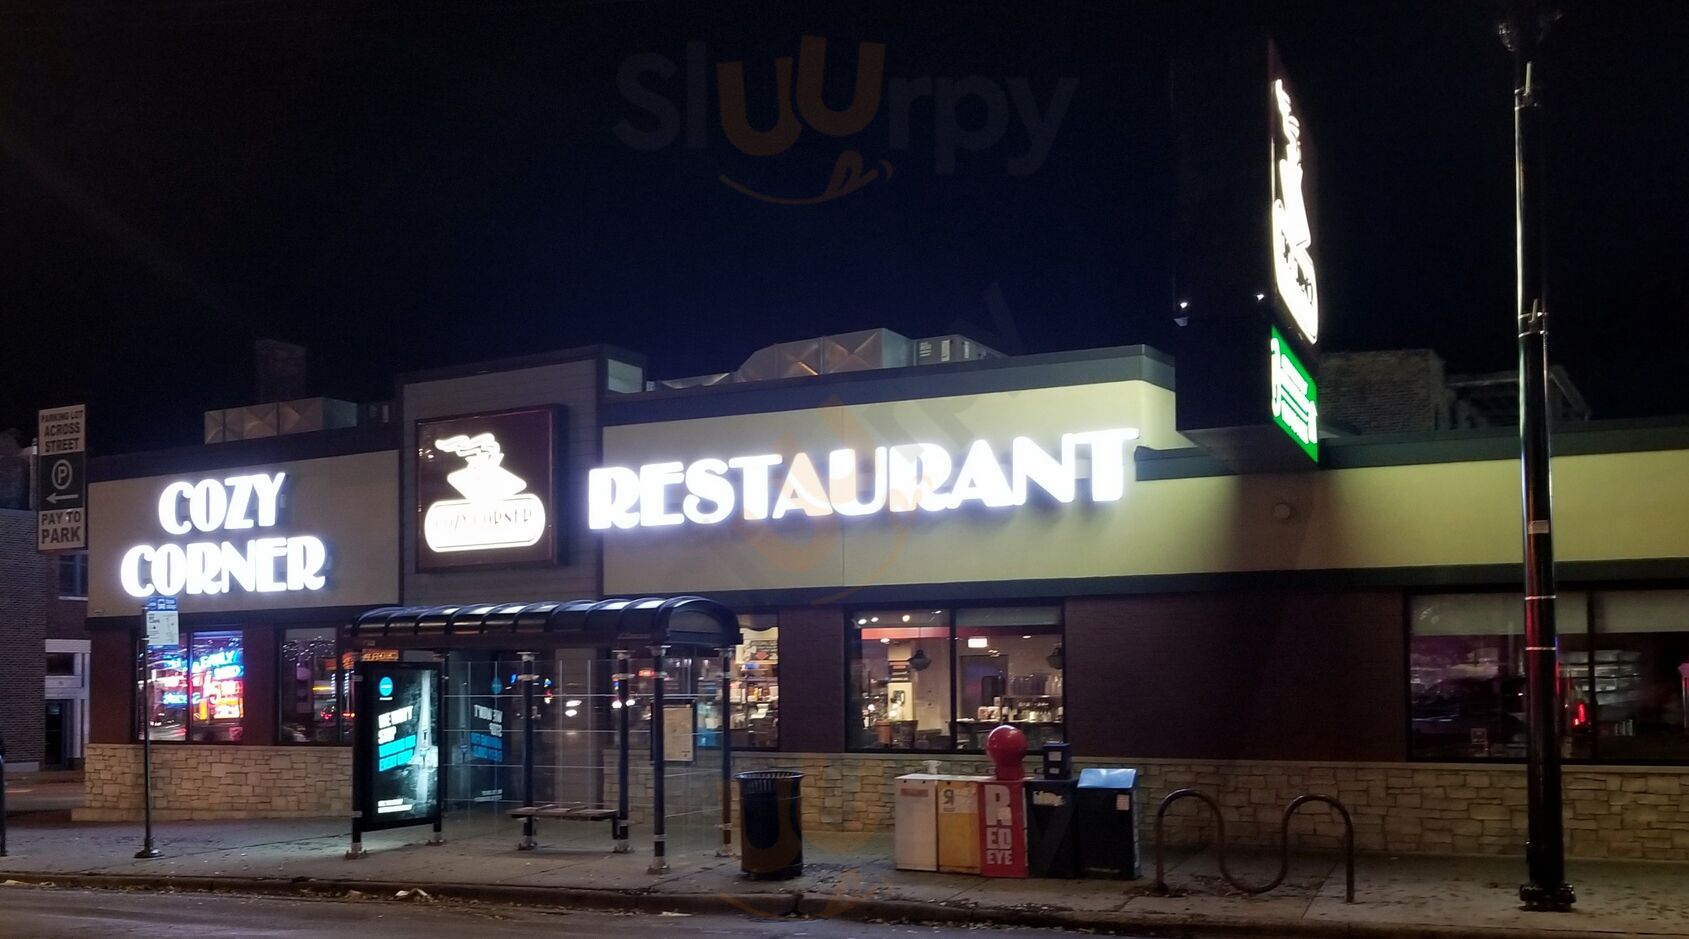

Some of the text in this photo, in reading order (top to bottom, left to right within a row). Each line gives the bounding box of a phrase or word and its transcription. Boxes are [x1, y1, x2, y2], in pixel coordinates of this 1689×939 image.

[41, 409, 84, 423] PARKING LOT
[43, 422, 81, 437] ACROSS
[44, 438, 79, 453] STREET
[588, 428, 1139, 531] RESTAURANT
[158, 472, 286, 535] COZY
[41, 510, 81, 526] PAY TO
[41, 525, 81, 544] PARK
[120, 535, 326, 598] CORNER
[986, 850, 1013, 865] EYE
